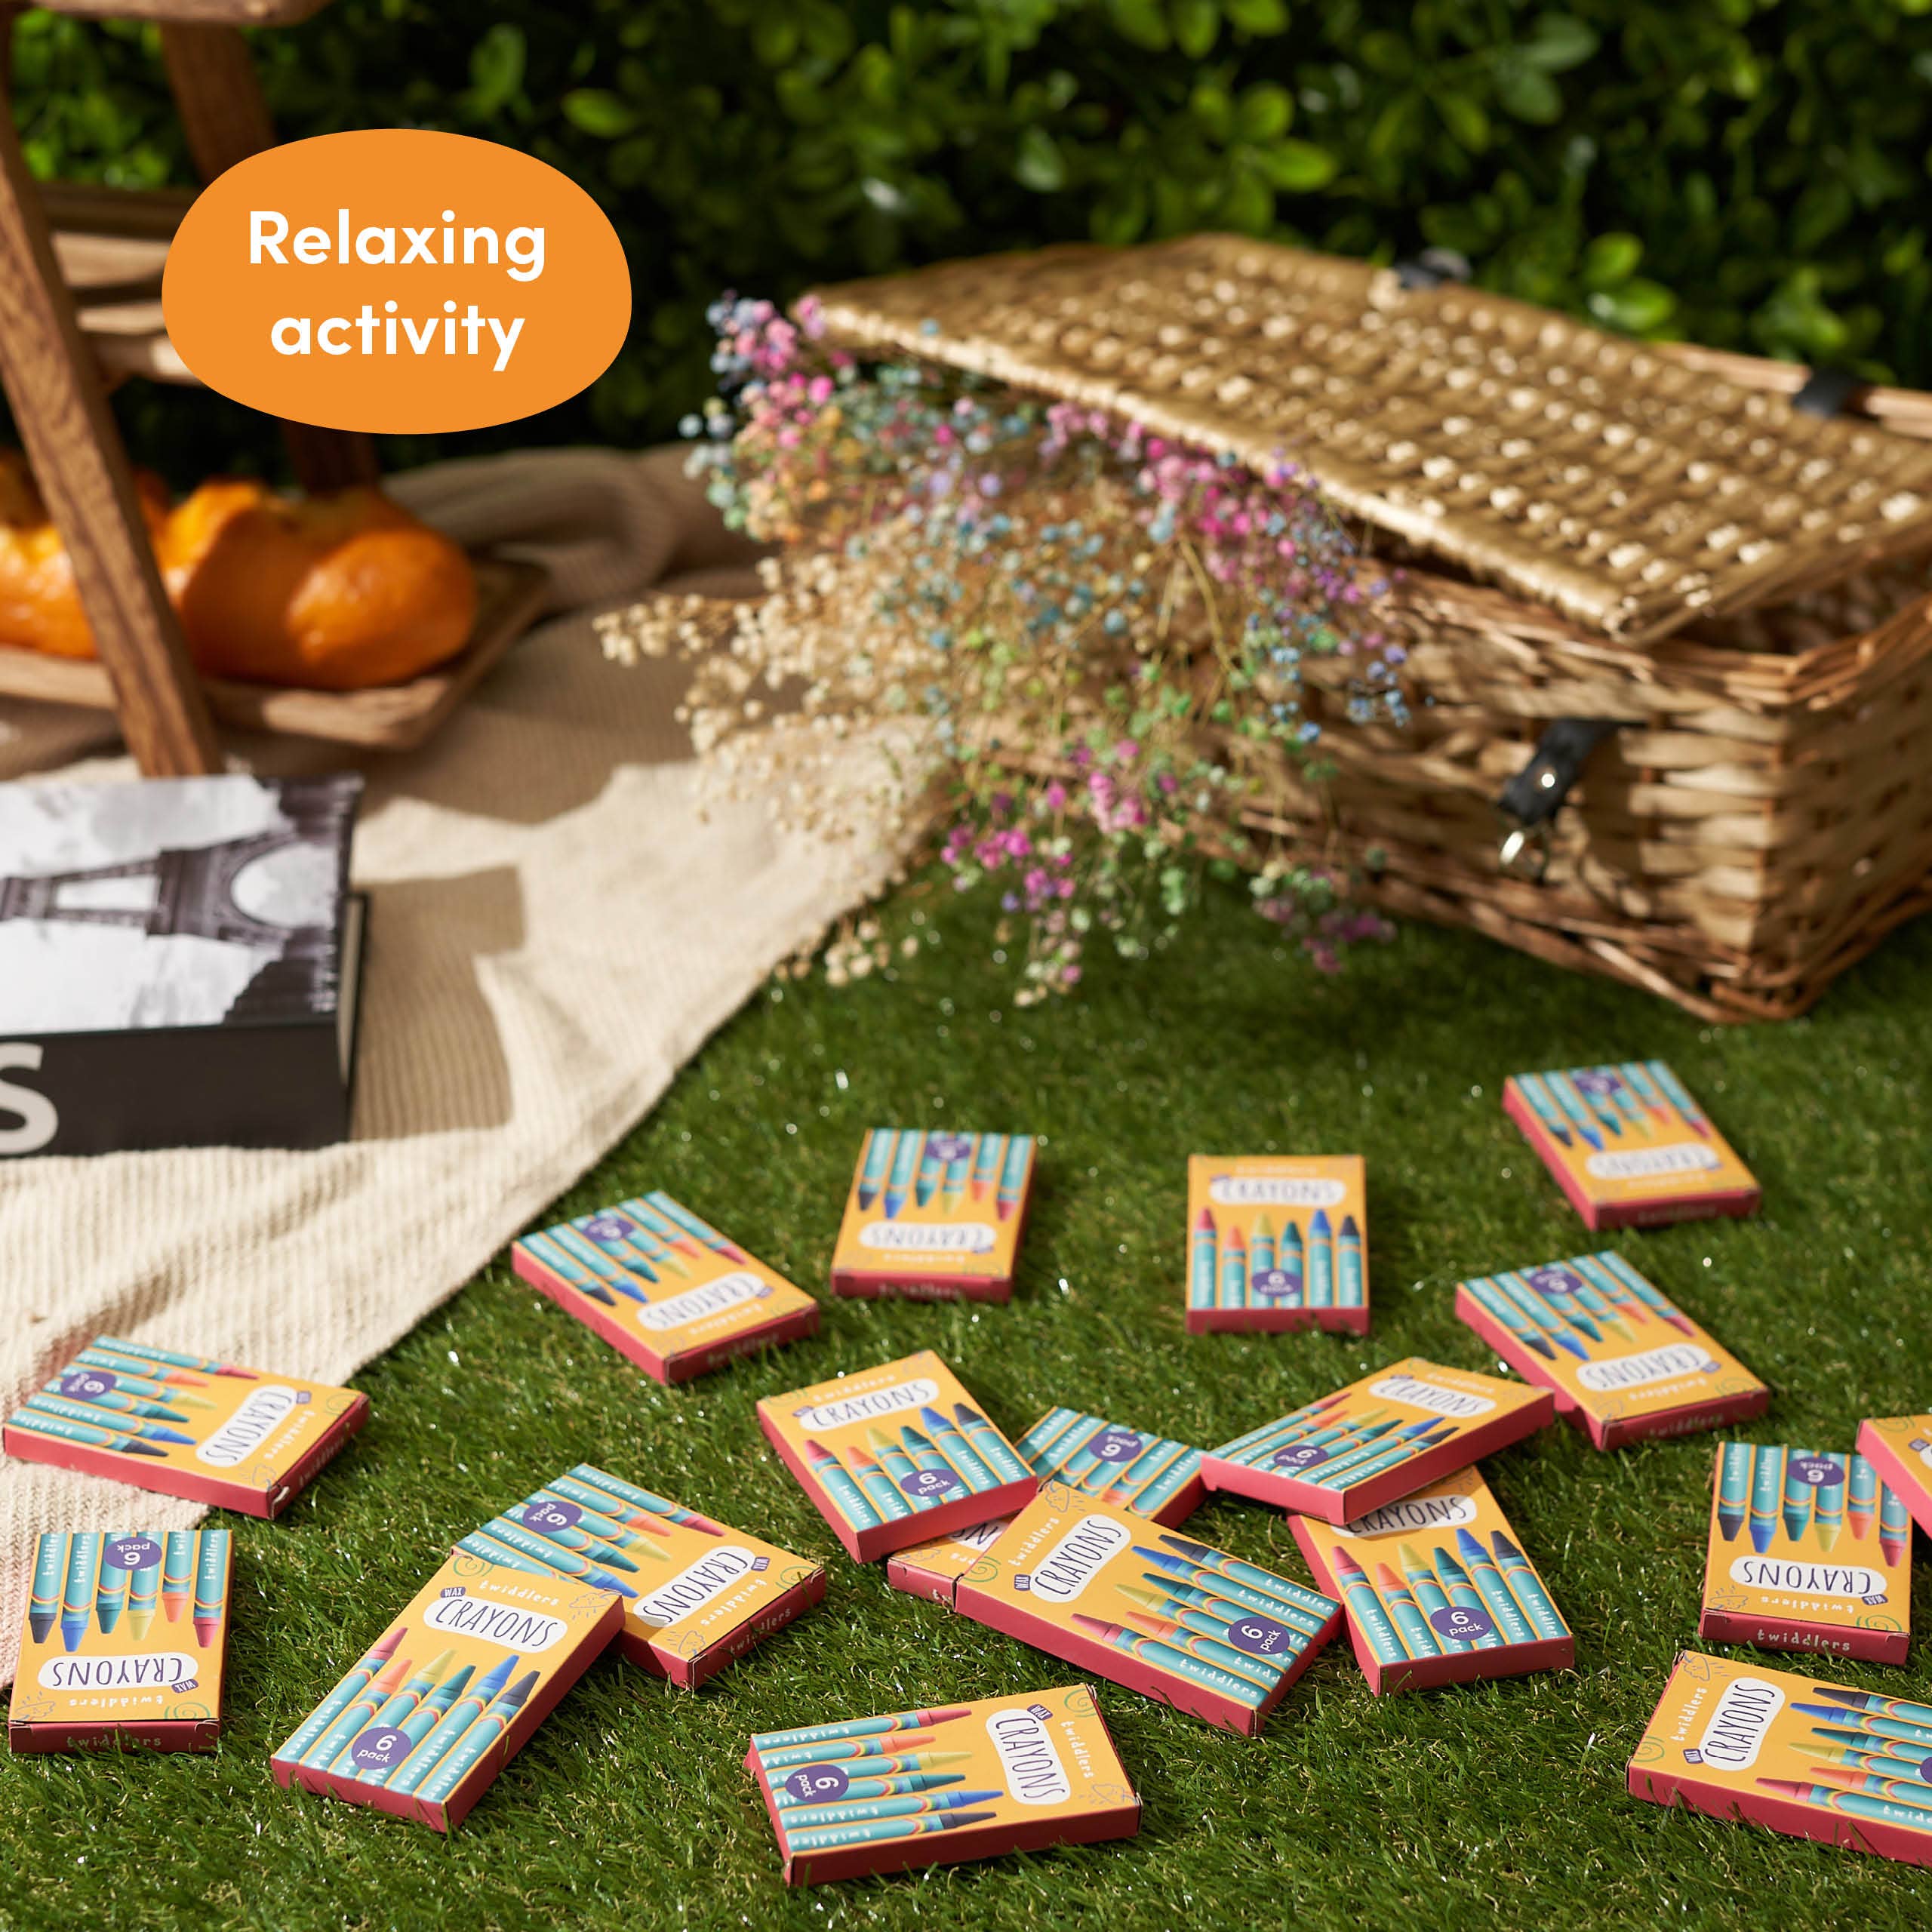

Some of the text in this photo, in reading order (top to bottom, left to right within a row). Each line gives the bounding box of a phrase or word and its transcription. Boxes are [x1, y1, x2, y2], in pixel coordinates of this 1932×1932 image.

[1586, 1349, 1700, 1386] CRAYONS
[83, 1381, 104, 1392] 6
[811, 1383, 928, 1426] CRAYONS
[1380, 1381, 1487, 1414] CRAYONS
[205, 1393, 292, 1461] CRAYONS
[1101, 1444, 1120, 1456] 6
[1297, 1449, 1317, 1458] 6
[918, 1472, 937, 1484] 6
[1807, 1469, 1823, 1481] 6
[918, 1480, 950, 1494] pack
[529, 1503, 555, 1521] pack
[546, 1513, 567, 1524] 6
[117, 1542, 149, 1552] pack
[490, 1524, 554, 1557] twiddlers
[1008, 1518, 1060, 1565] twiddlers
[74, 1534, 91, 1582] twiddlers
[124, 1552, 140, 1564] 6
[752, 1558, 768, 1569] WAX
[1035, 1520, 1121, 1595] CRAYONS
[643, 1552, 747, 1622] CRAYONS
[1016, 1576, 1029, 1588] WAX
[1743, 1561, 1870, 1595] CRAYONS
[444, 1589, 462, 1597] WAX
[479, 1580, 558, 1606] twiddlers
[700, 1579, 766, 1624] twiddlers
[1263, 1579, 1332, 1611] twiddler
[1863, 1595, 1885, 1603] WAX
[1235, 1590, 1315, 1626] twiddlers
[1489, 1590, 1525, 1638] twiddlers
[1761, 1596, 1854, 1613] twiddlers
[435, 1598, 558, 1646] CRAYONS
[1451, 1611, 1469, 1625] 6
[1240, 1625, 1263, 1638] 6
[1364, 1609, 1398, 1657] twiddlers
[1449, 1623, 1483, 1635] pack
[1260, 1630, 1281, 1651] pack
[1757, 1629, 1851, 1652] twiddlers
[53, 1657, 181, 1687] CRAYONS
[1177, 1659, 1259, 1697] twiddlers
[174, 1680, 195, 1690] WAX
[69, 1695, 162, 1707] twiddlers
[1029, 1706, 1048, 1718] WAX
[1671, 1688, 1708, 1740] twiddlers
[286, 1699, 342, 1755] twiddlers
[1704, 1684, 1775, 1762] CRAYONS
[376, 1734, 396, 1751] 6
[761, 1726, 849, 1744] twiddlers
[356, 1749, 390, 1762] pack
[398, 1728, 454, 1786] twiddlers
[995, 1719, 1066, 1798] CRAYONS
[1060, 1721, 1094, 1777] twiddlers
[795, 1774, 816, 1796] pack
[814, 1777, 838, 1789] 6
[787, 1804, 878, 1823] twiddlers
